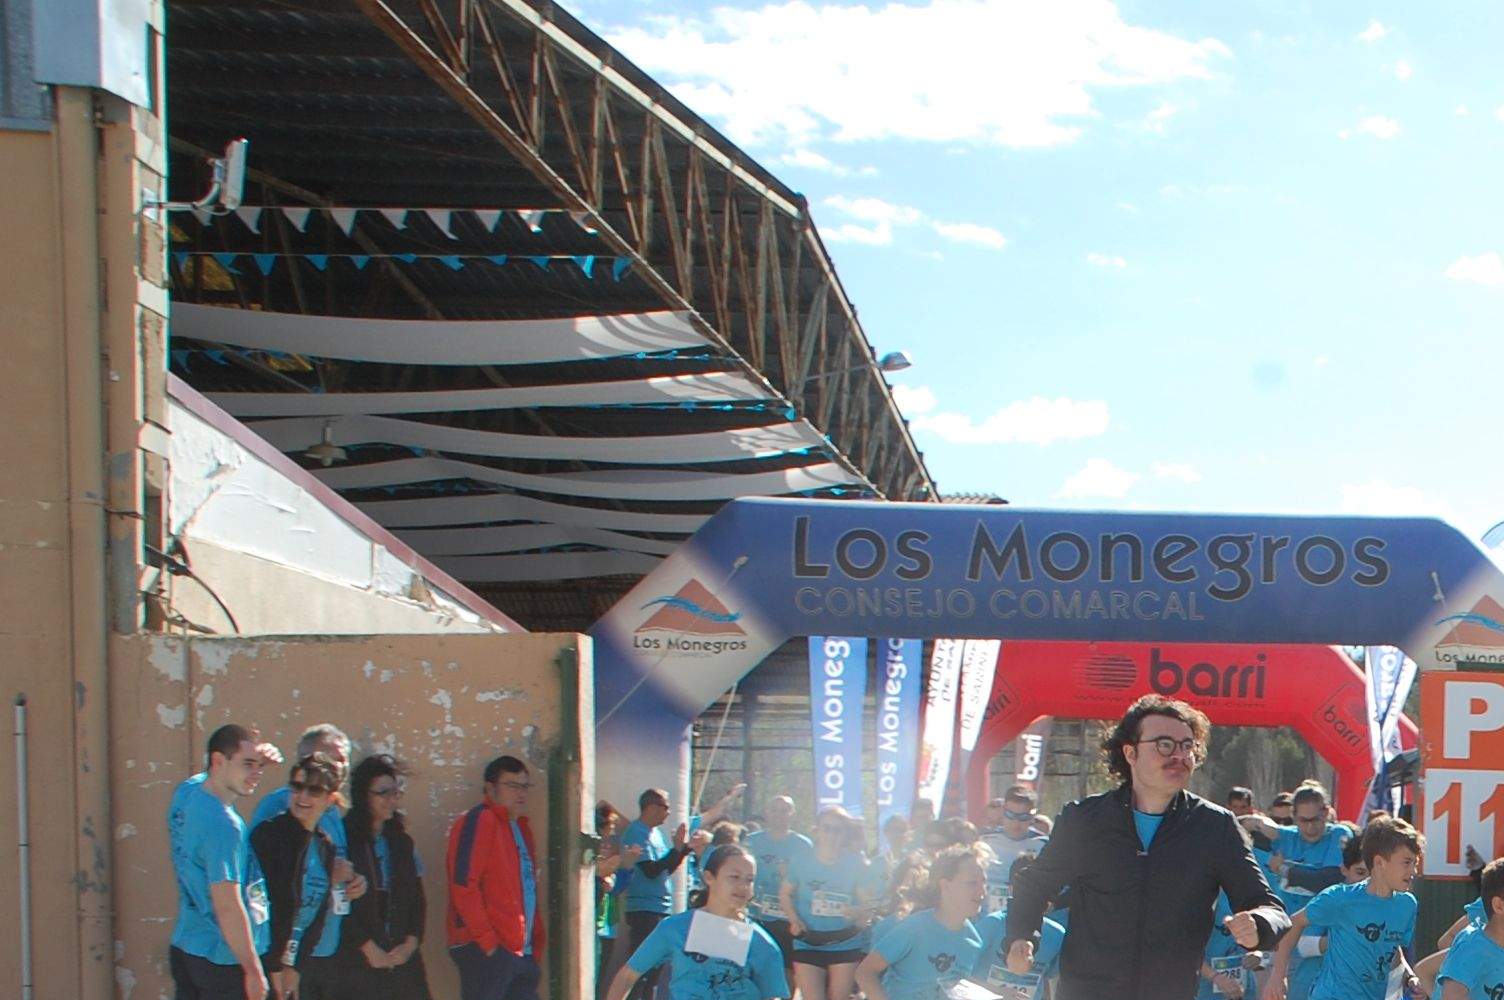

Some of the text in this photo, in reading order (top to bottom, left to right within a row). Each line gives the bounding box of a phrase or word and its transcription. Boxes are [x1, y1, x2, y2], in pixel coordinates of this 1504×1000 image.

[792, 515, 1391, 601] Los Monegros
[794, 586, 1205, 621] CONSEJO COMARCAL
[632, 635, 748, 654] Los Monegros
[1150, 647, 1266, 698] barri
[1323, 704, 1362, 748] barri
[820, 754, 844, 805] Los
[1017, 733, 1044, 781] barri
[877, 762, 898, 806] Los
